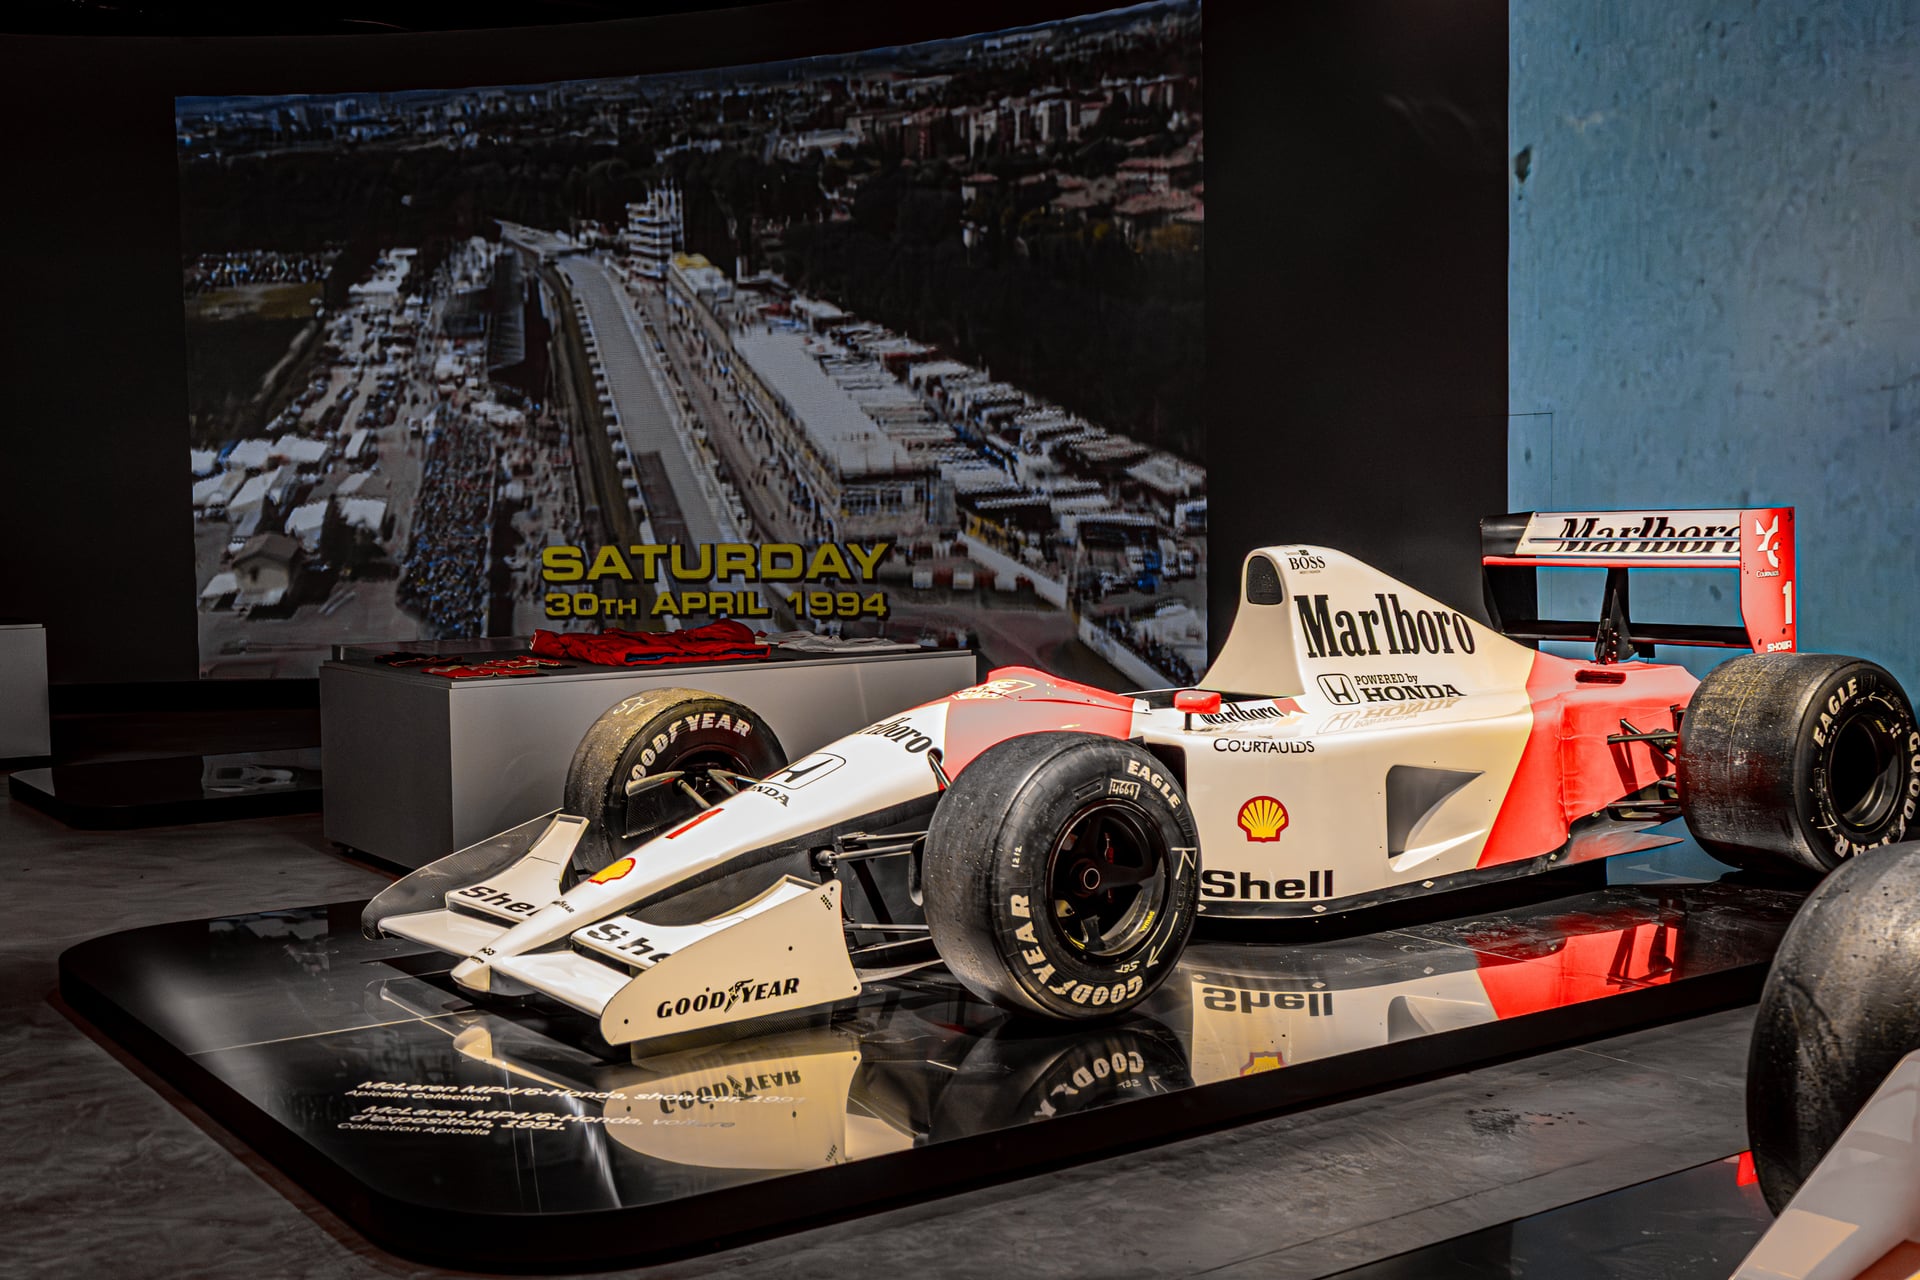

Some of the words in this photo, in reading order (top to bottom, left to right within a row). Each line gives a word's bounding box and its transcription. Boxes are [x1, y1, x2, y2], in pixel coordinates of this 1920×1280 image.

[542, 543, 891, 581] SATURDAY
[1288, 556, 1326, 570] BOSS
[545, 593, 637, 616] 30TH
[651, 591, 770, 616] APRIL
[786, 592, 888, 617] 1994
[1782, 580, 1792, 625] 1
[1293, 593, 1475, 658] Marlboro
[1354, 673, 1405, 685] POWERED
[1406, 673, 1418, 684] by
[1360, 684, 1468, 702] HONDA
[1813, 677, 1858, 748] EAGLE
[625, 713, 752, 794] OODYEAR
[1213, 738, 1315, 753] COURTAULDS
[1127, 759, 1182, 809] EAGLE
[751, 785, 790, 807] NDA
[1201, 870, 1333, 899] Shell
[458, 886, 544, 917] Shel
[344, 1089, 408, 1098] Apicella
[411, 1092, 491, 1102] Collection
[357, 1081, 459, 1093] McLaren
[361, 1105, 467, 1117] McLaren
[337, 1122, 420, 1133] Collection
[423, 1126, 491, 1136] Apicella
[501, 1120, 566, 1131] 1991.
